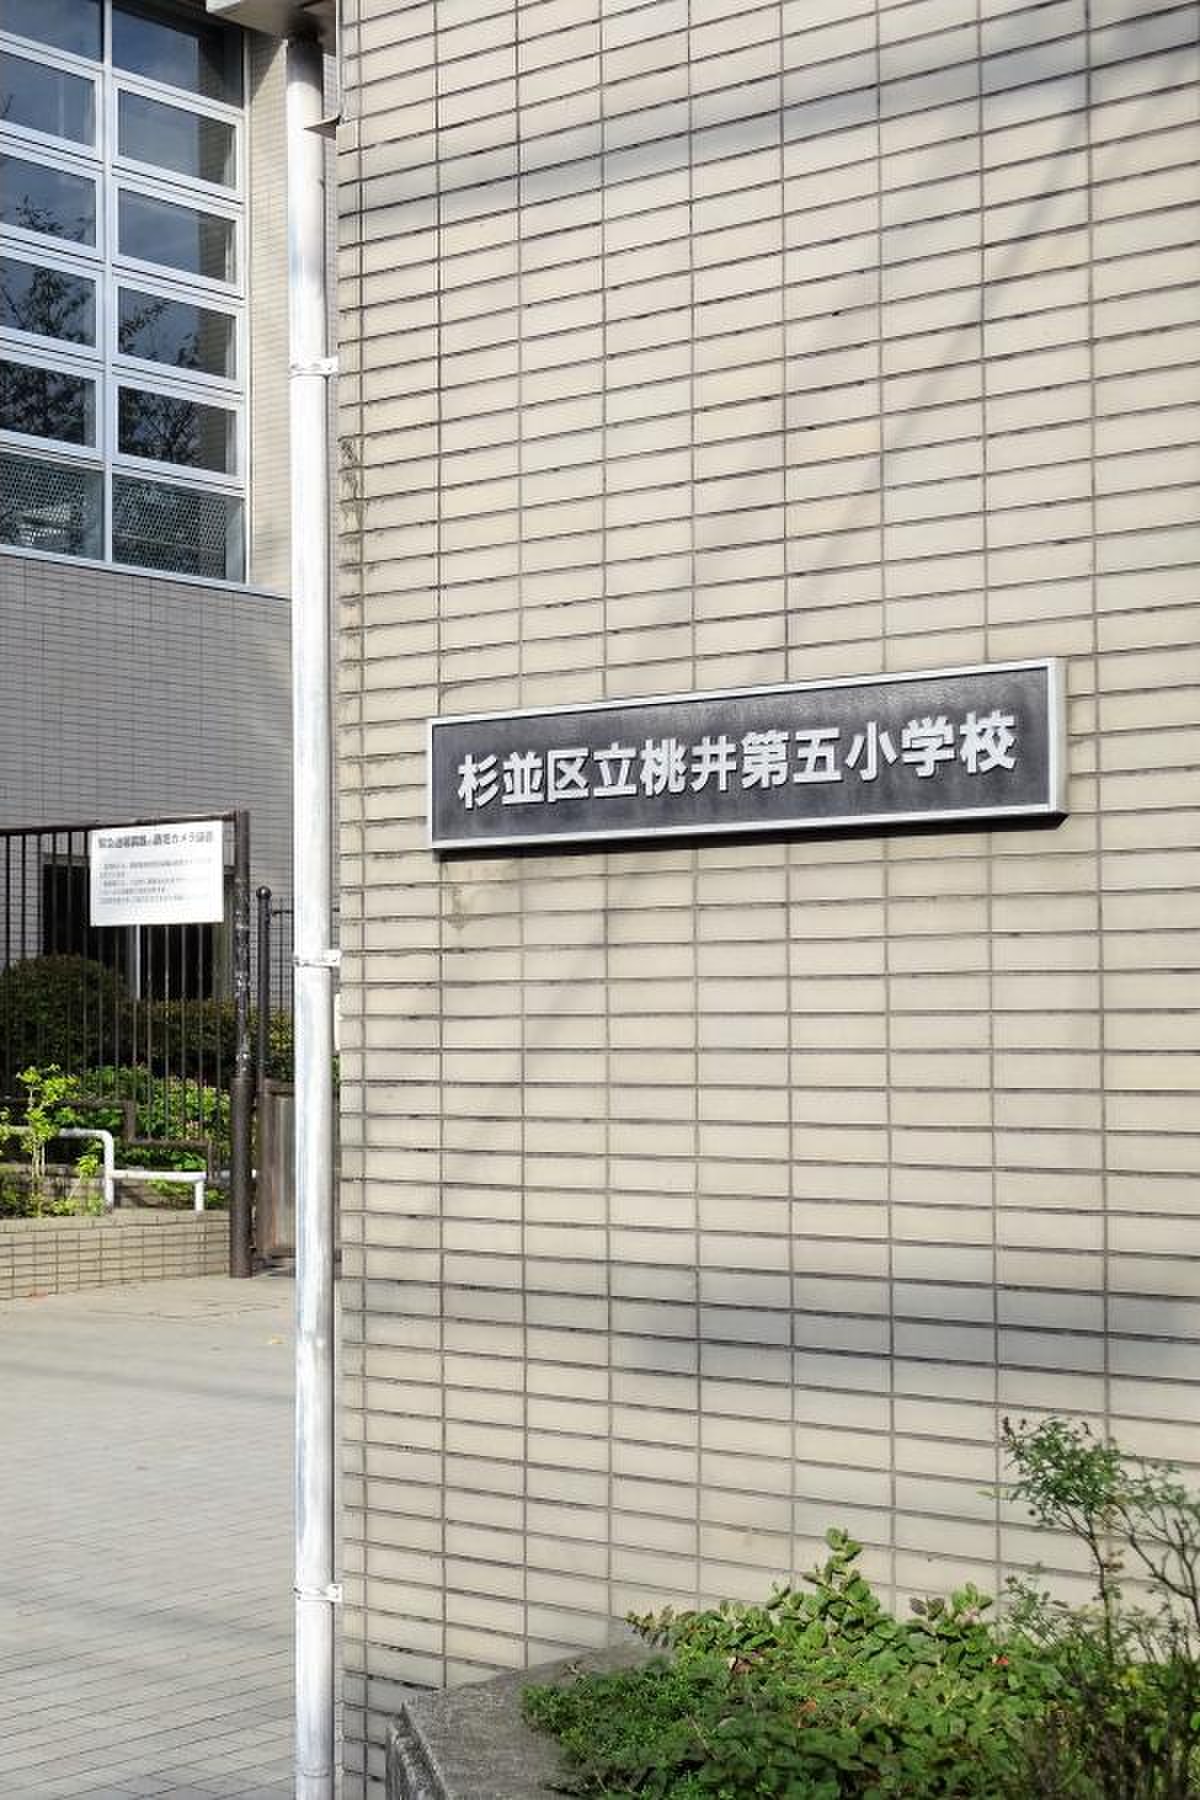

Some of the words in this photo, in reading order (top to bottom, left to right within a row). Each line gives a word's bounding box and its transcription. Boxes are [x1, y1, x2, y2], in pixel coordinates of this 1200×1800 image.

[457, 711, 1017, 809] 杉並区立桃井第五小学校
